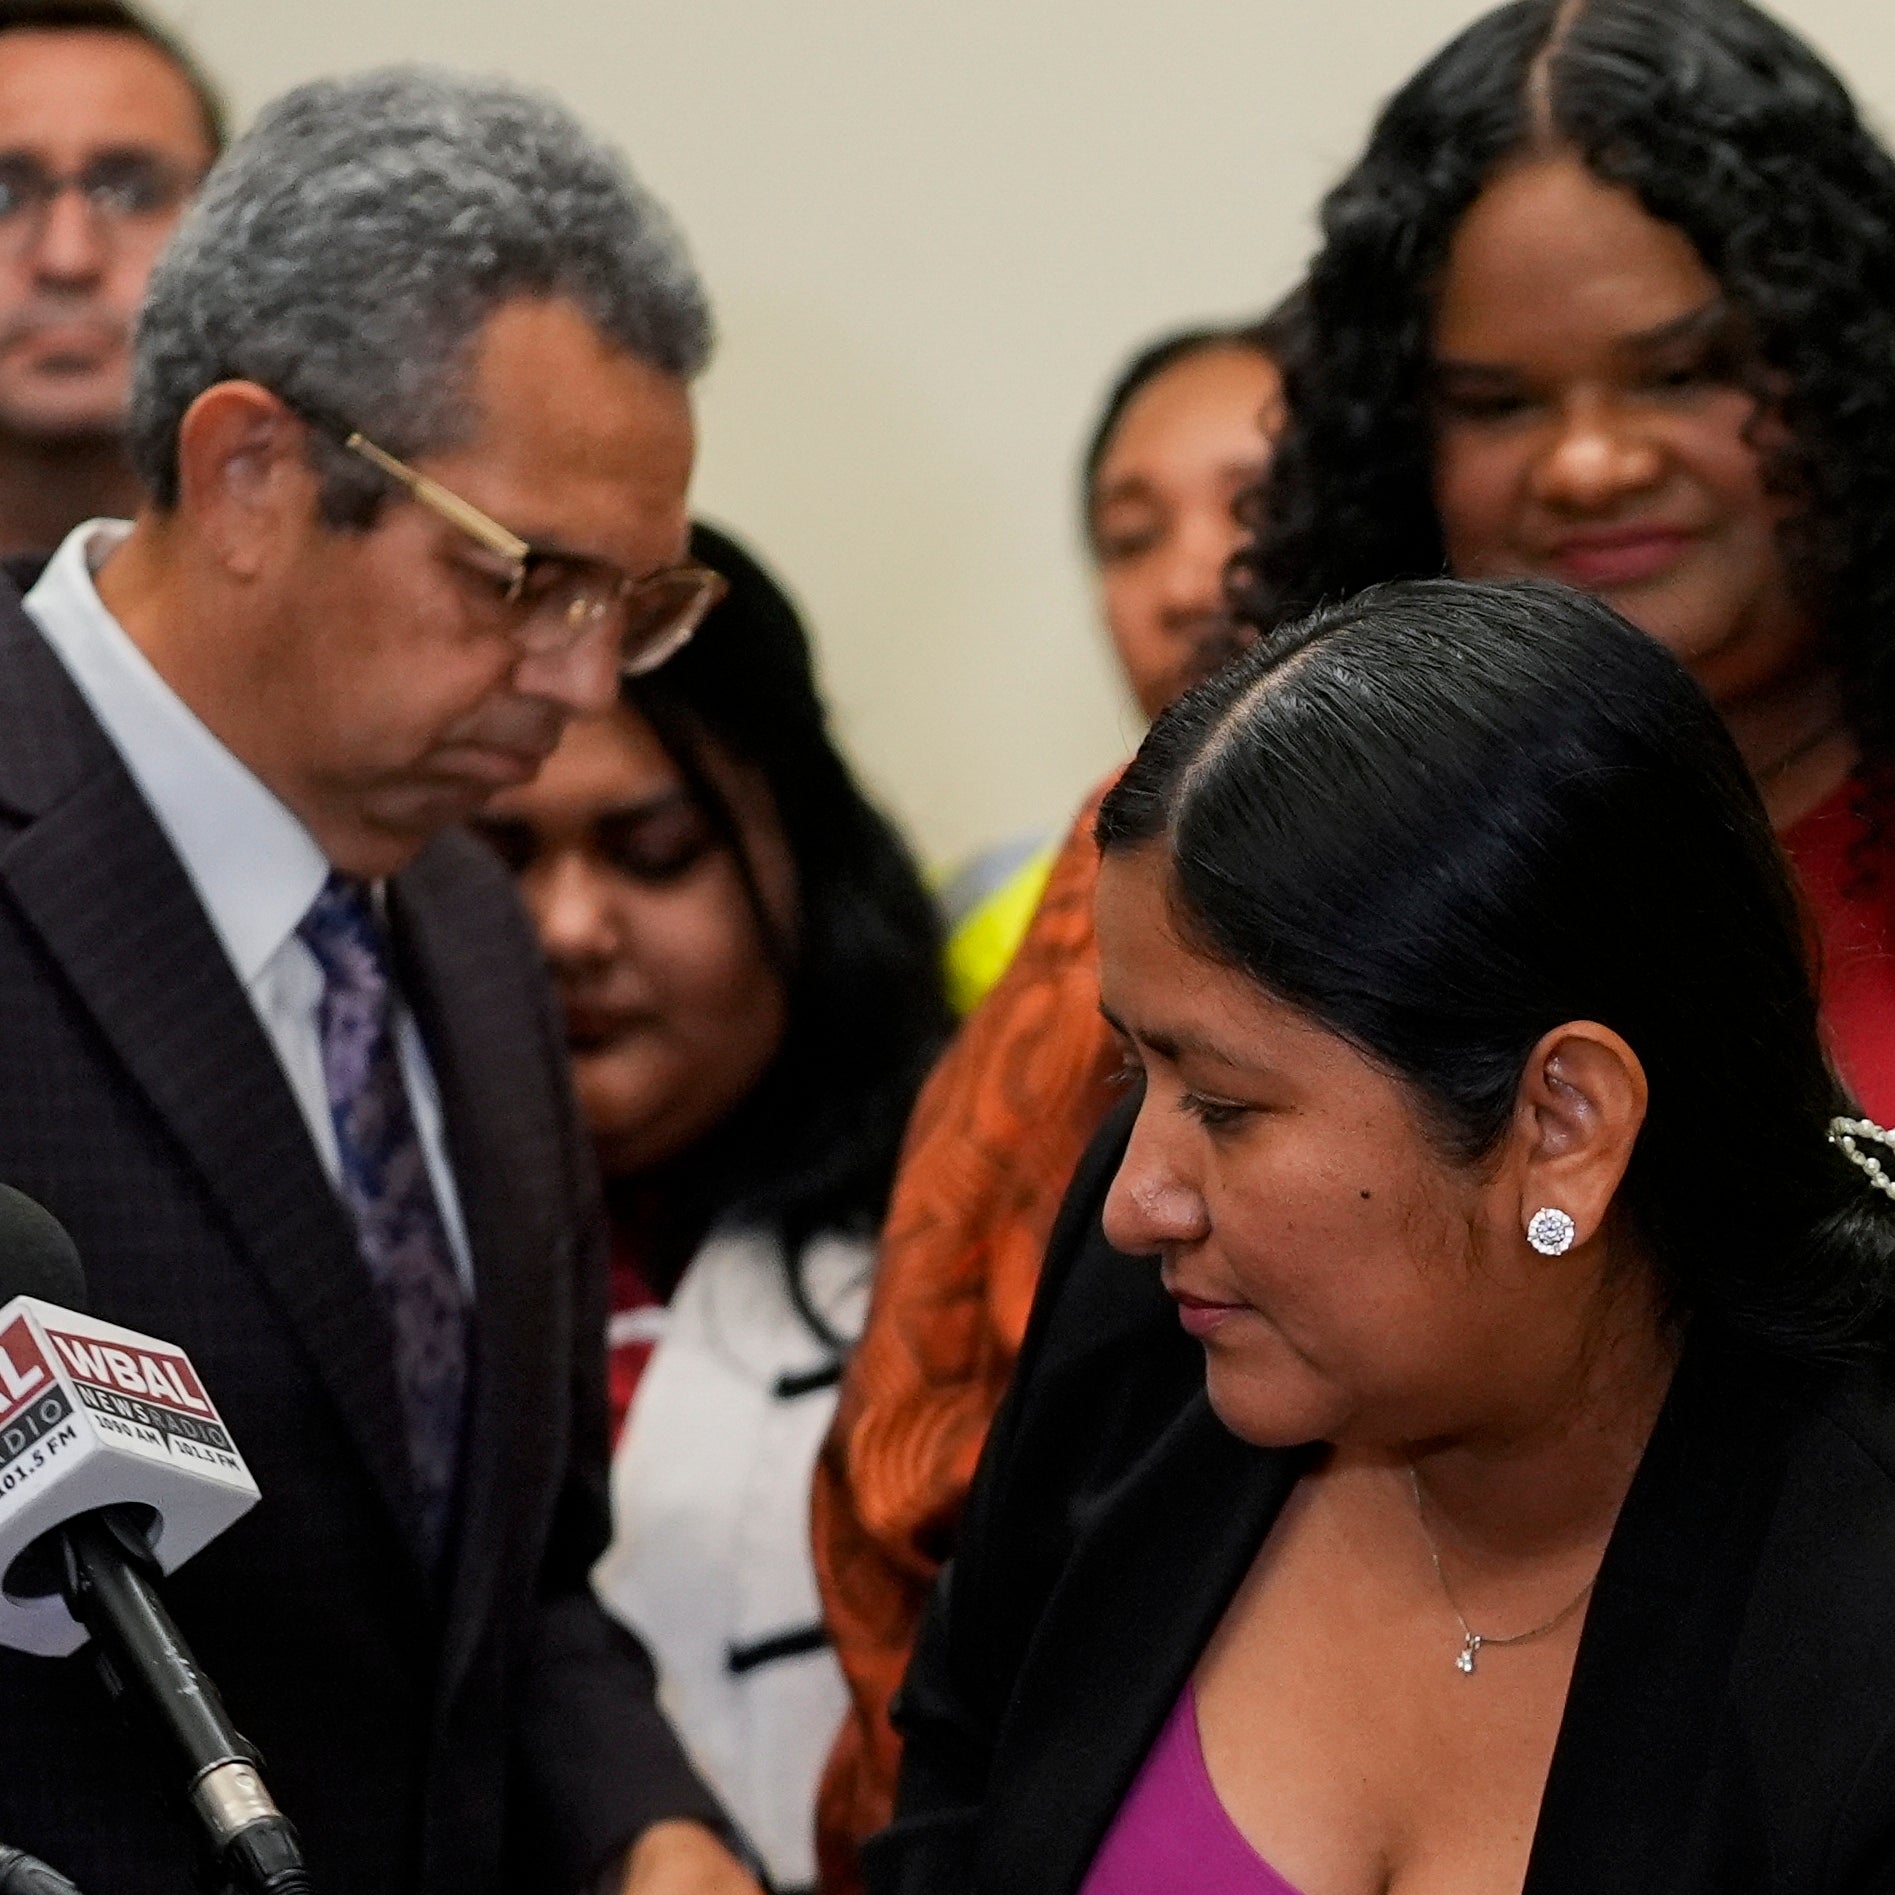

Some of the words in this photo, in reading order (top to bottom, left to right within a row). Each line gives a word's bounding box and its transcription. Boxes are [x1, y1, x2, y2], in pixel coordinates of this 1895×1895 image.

[51, 1335, 209, 1412] WBAL
[0, 1399, 62, 1465] DIO
[46, 1424, 77, 1456] FM
[135, 1425, 162, 1446] AM
[218, 1453, 242, 1472] FM
